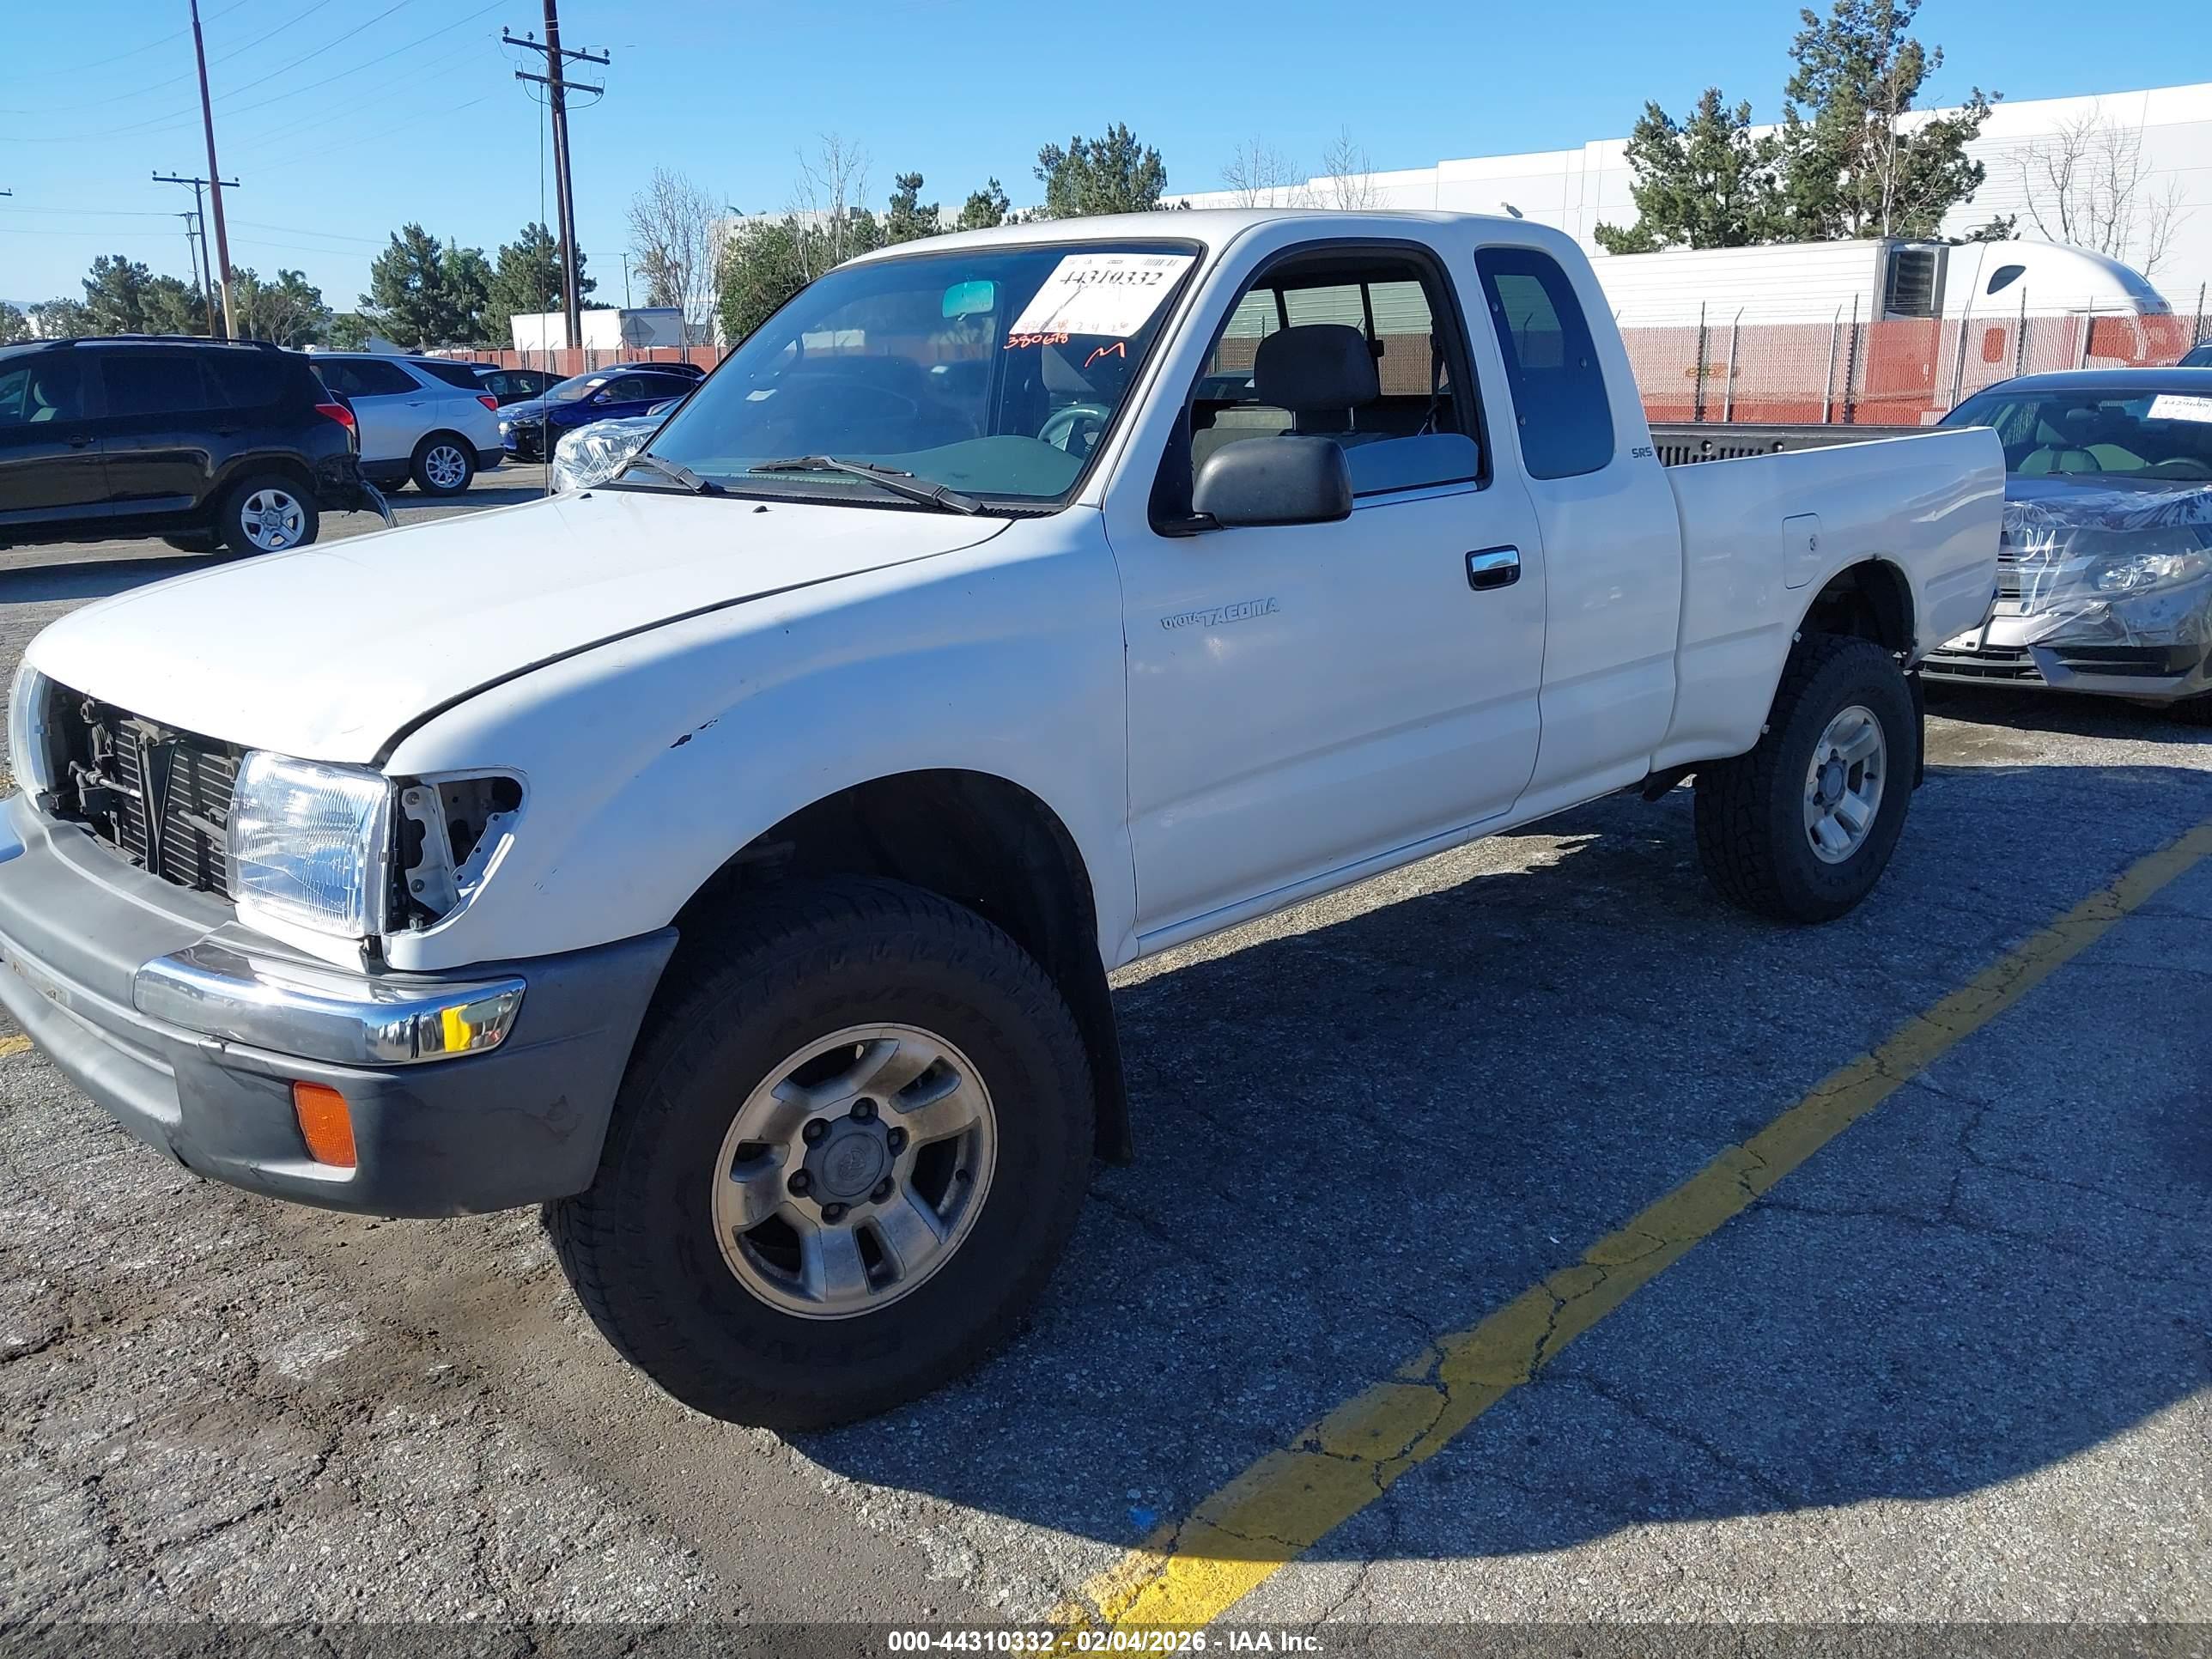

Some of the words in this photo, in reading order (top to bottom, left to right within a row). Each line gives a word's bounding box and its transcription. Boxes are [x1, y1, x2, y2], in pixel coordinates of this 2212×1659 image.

[1060, 270, 1164, 286] 44310332
[1003, 332, 1069, 349] 380678
[1632, 447, 1653, 459] SR5
[1197, 598, 1279, 627] TACOMA
